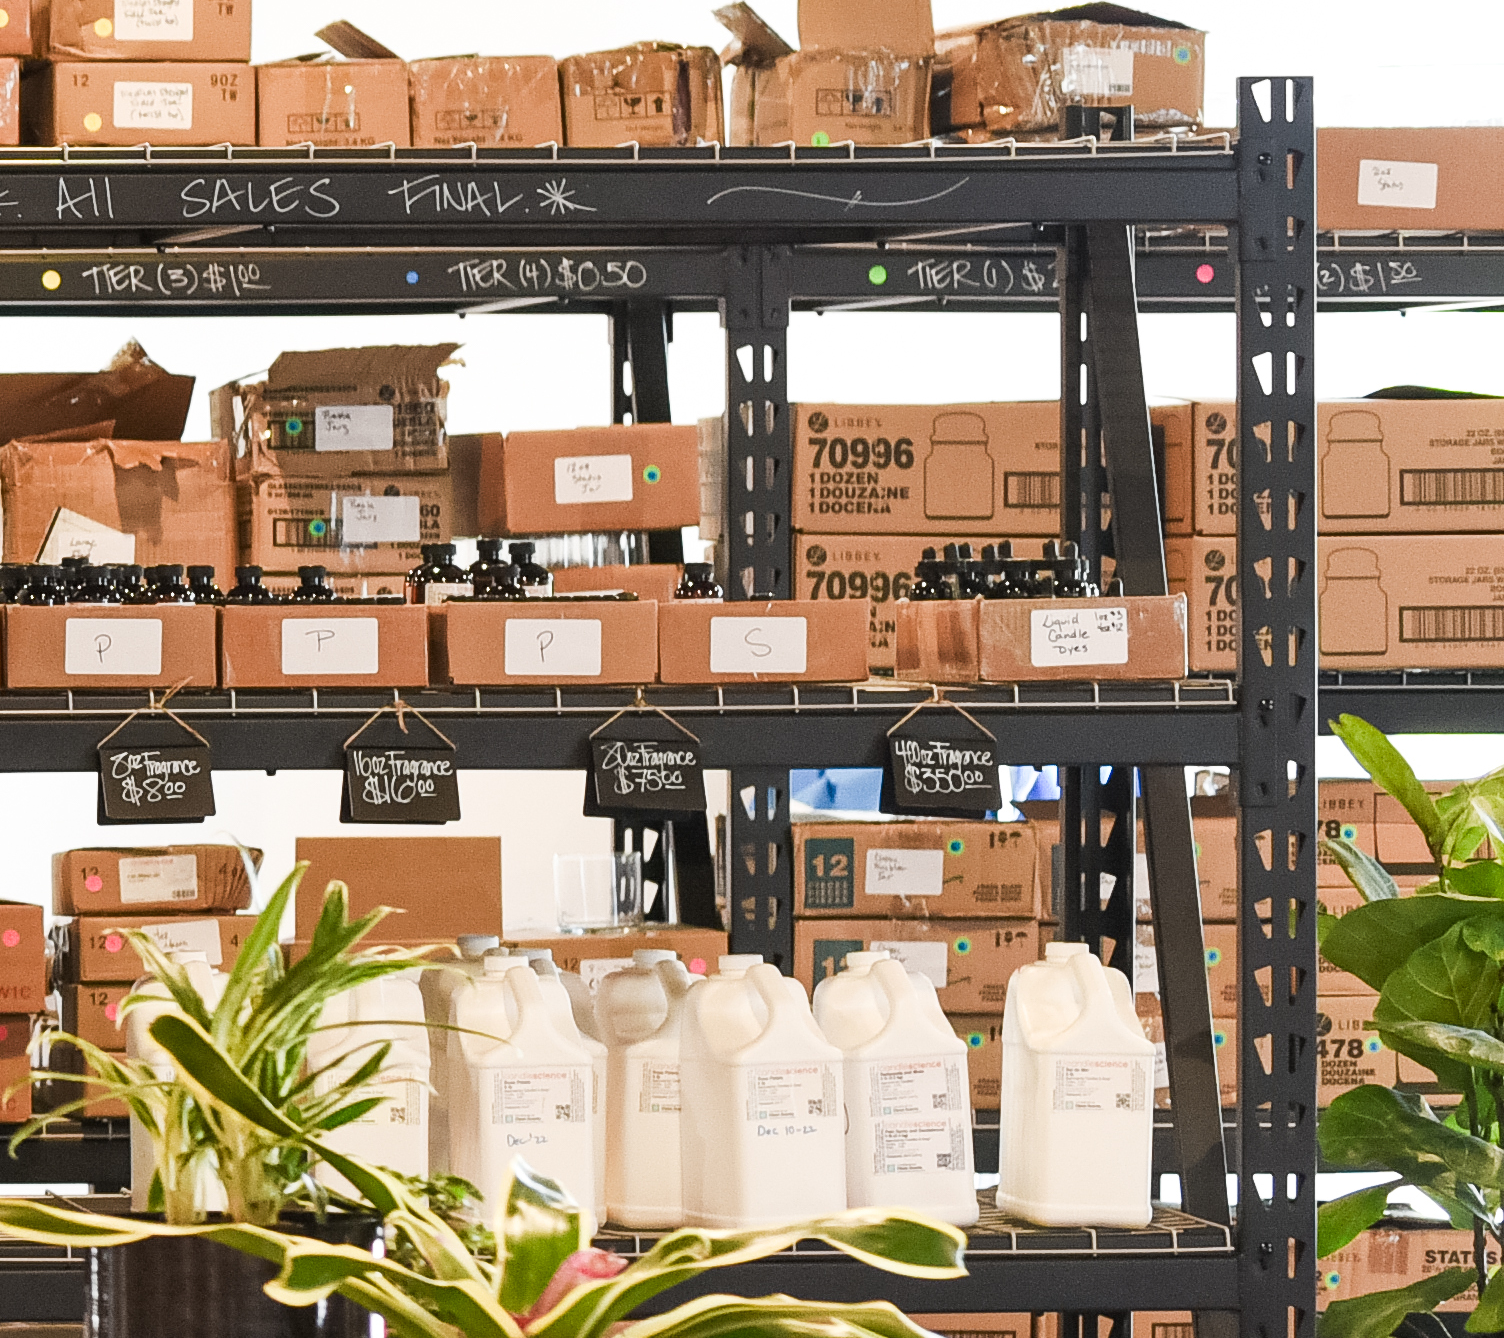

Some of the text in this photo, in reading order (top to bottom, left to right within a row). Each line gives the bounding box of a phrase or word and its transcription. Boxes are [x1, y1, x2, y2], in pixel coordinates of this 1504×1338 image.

[72, 74, 89, 86] 12
[56, 176, 114, 220] All
[180, 177, 340, 217] SALES
[83, 265, 154, 295] TIER
[157, 265, 199, 295] (3)
[448, 262, 508, 292] TIER
[519, 261, 552, 289] (4)
[908, 260, 973, 290] TIER
[809, 437, 914, 469] 70996
[809, 472, 878, 485] 1 DOZEN
[809, 487, 910, 499] 1 DOUZAINE
[809, 502, 816, 513] 1
[807, 571, 912, 600] 70996
[1043, 615, 1080, 630] Liquid
[1048, 629, 1089, 640] Candle
[95, 633, 112, 663] P
[305, 629, 335, 652] P
[536, 630, 554, 663] P
[744, 628, 773, 657] S
[1056, 645, 1088, 653] Dyes
[144, 752, 200, 782] Fragrance
[389, 751, 452, 784] Fragrance
[641, 742, 696, 775] Fragrance
[933, 742, 993, 770] Fragrance
[812, 855, 847, 877] 12
[89, 992, 108, 1006] 12
[504, 1071, 567, 1080] candlescience
[1067, 1060, 1128, 1068] candlescience
[757, 1125, 778, 1136] Dec
